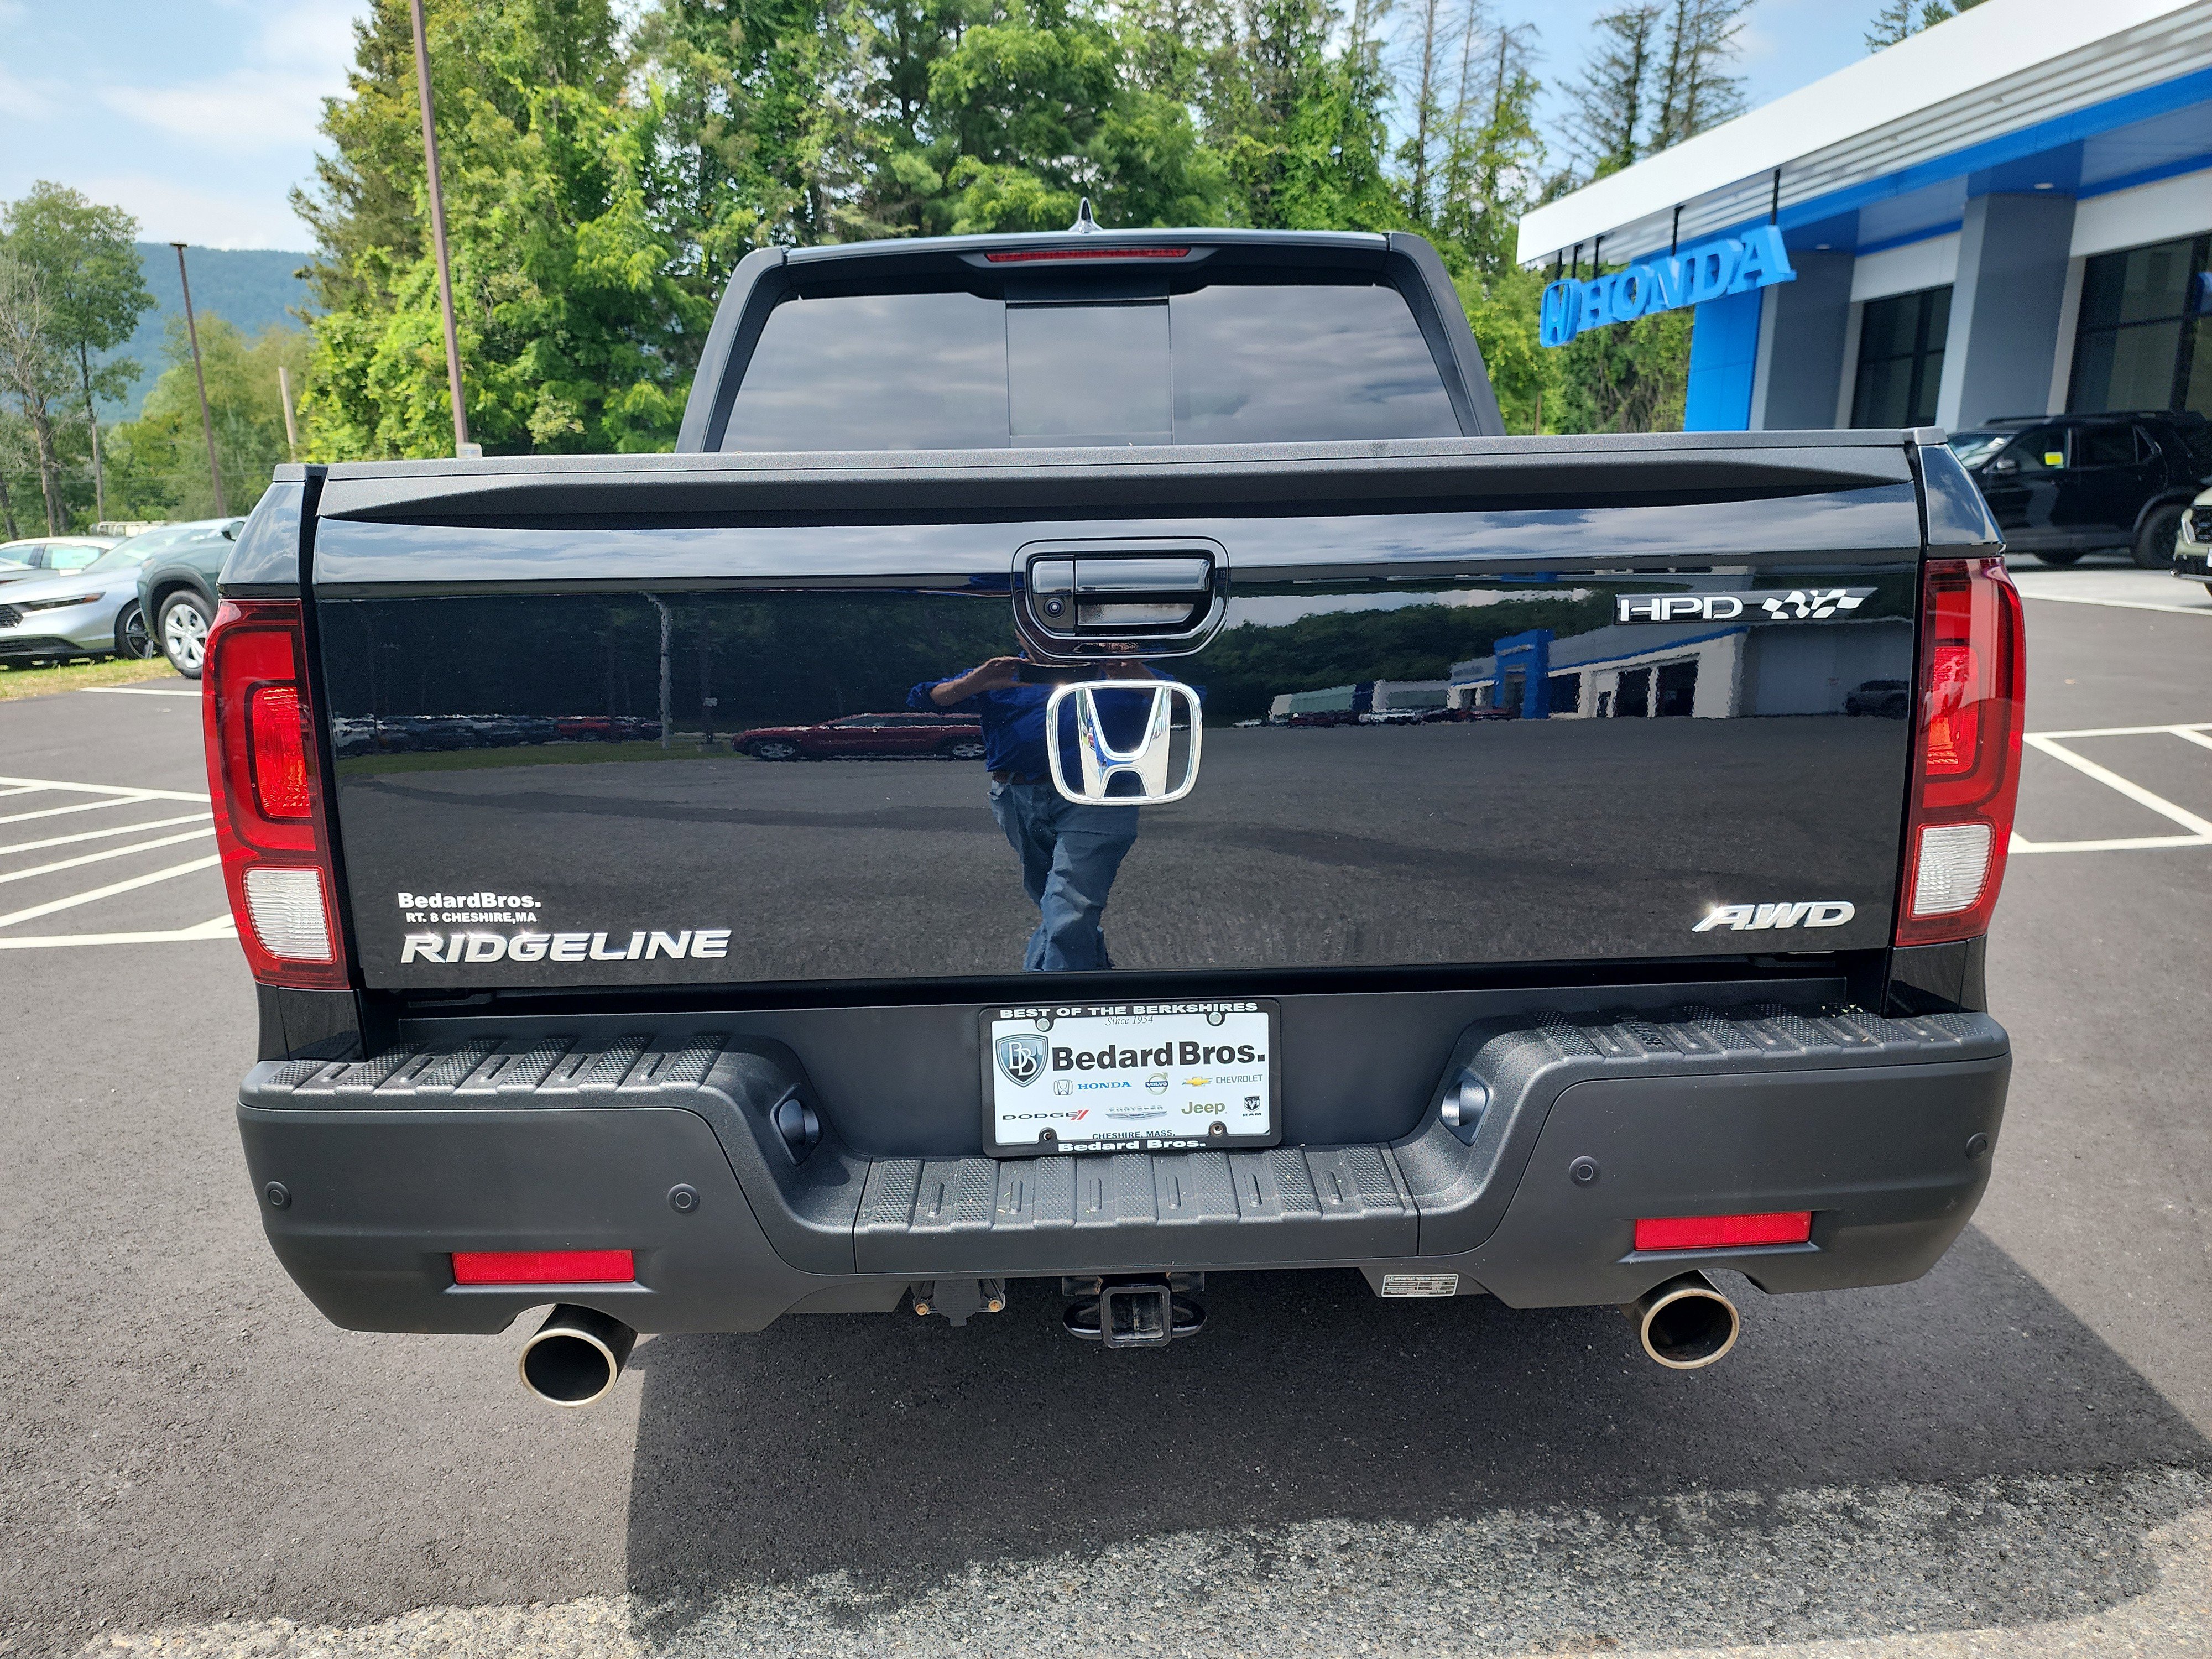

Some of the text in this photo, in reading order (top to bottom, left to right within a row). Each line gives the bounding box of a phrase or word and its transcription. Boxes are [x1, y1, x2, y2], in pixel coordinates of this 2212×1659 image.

[1576, 225, 1797, 332] HONDA
[1620, 596, 1743, 621] HPD
[406, 912, 426, 922] RT.
[430, 913, 439, 922] 8
[1692, 901, 1855, 932] AWD
[401, 930, 731, 963] RIDGELINE
[1000, 1003, 1258, 1019] BEST OF THE BERKSHIRES
[1105, 1015, 1154, 1026] Since 1954
[1077, 1081, 1132, 1089] HONDA
[1216, 1074, 1263, 1084] CHEVROLET
[1181, 1102, 1225, 1115] Jeep
[1003, 1112, 1078, 1120] DODGE
[1058, 1139, 1206, 1152] Bedard Bros.
